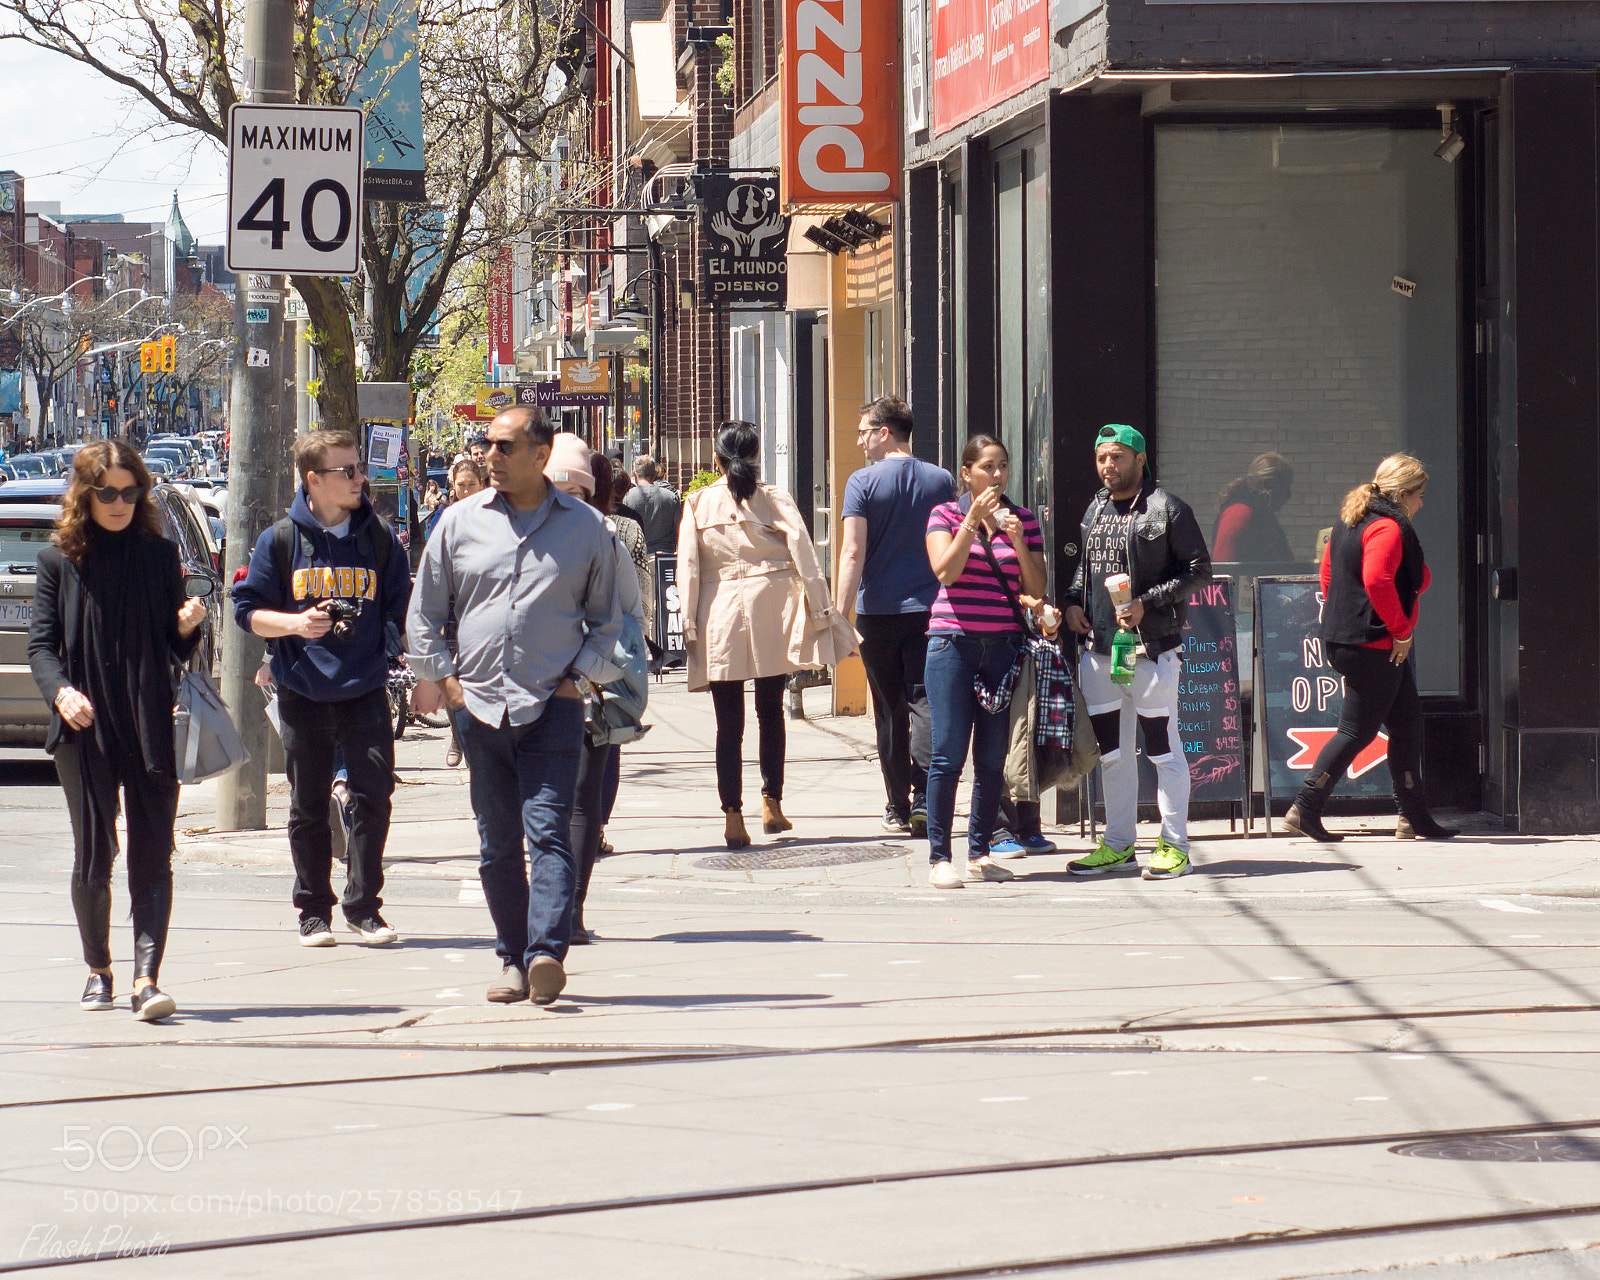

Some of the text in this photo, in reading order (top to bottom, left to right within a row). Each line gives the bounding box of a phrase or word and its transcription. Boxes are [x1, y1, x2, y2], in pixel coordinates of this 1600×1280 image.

[797, 0, 890, 192] pizz
[241, 125, 352, 152] MAXIMUM
[237, 177, 352, 253] 40
[709, 258, 787, 275] EL MUNDO
[714, 281, 779, 292] DISEÑO
[293, 567, 377, 600] HUMBER
[1224, 679, 1236, 694] $5
[1292, 676, 1346, 713] OP
[1225, 696, 1237, 711] $5
